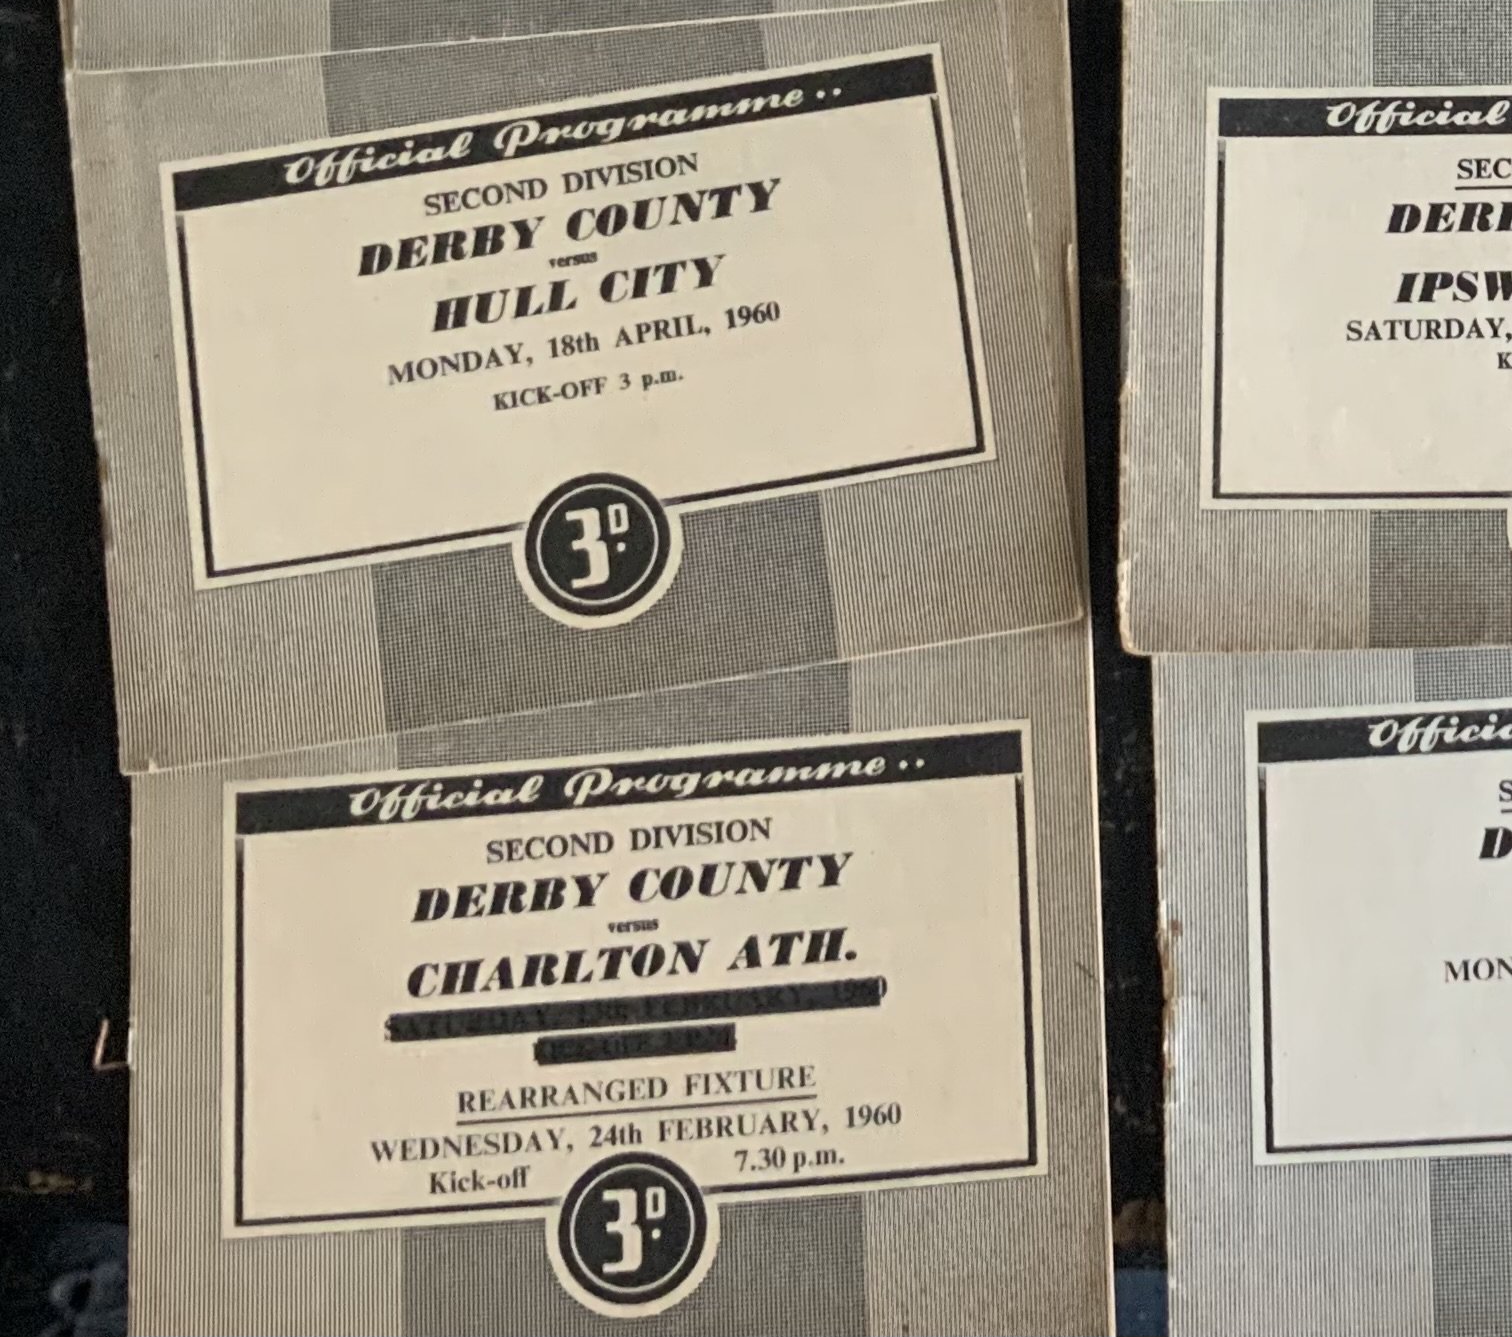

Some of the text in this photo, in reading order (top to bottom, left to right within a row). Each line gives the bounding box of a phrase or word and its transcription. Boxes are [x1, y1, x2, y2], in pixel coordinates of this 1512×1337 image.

[423, 152, 698, 217] SECOND DIVISION
[357, 178, 783, 277] DERBY COUNTY
[432, 254, 725, 333] HULL CITY
[388, 301, 781, 386] MONDAY, 18th APRIL, 1960
[1346, 317, 1512, 343] SATURDAY,
[493, 370, 684, 411] KICK-OFF 3 p.m.
[486, 816, 772, 865] SECOND DIVISION
[412, 851, 853, 923] DERBY COUNTY
[407, 927, 857, 998] CHARLTON ATH.
[458, 1065, 815, 1114] REARRANGED FIXTURE
[371, 1103, 902, 1163] WEDNESDAY, 24th FEBRUARY, 1960
[429, 1146, 845, 1195] Kick-off 7.30 p.m.
